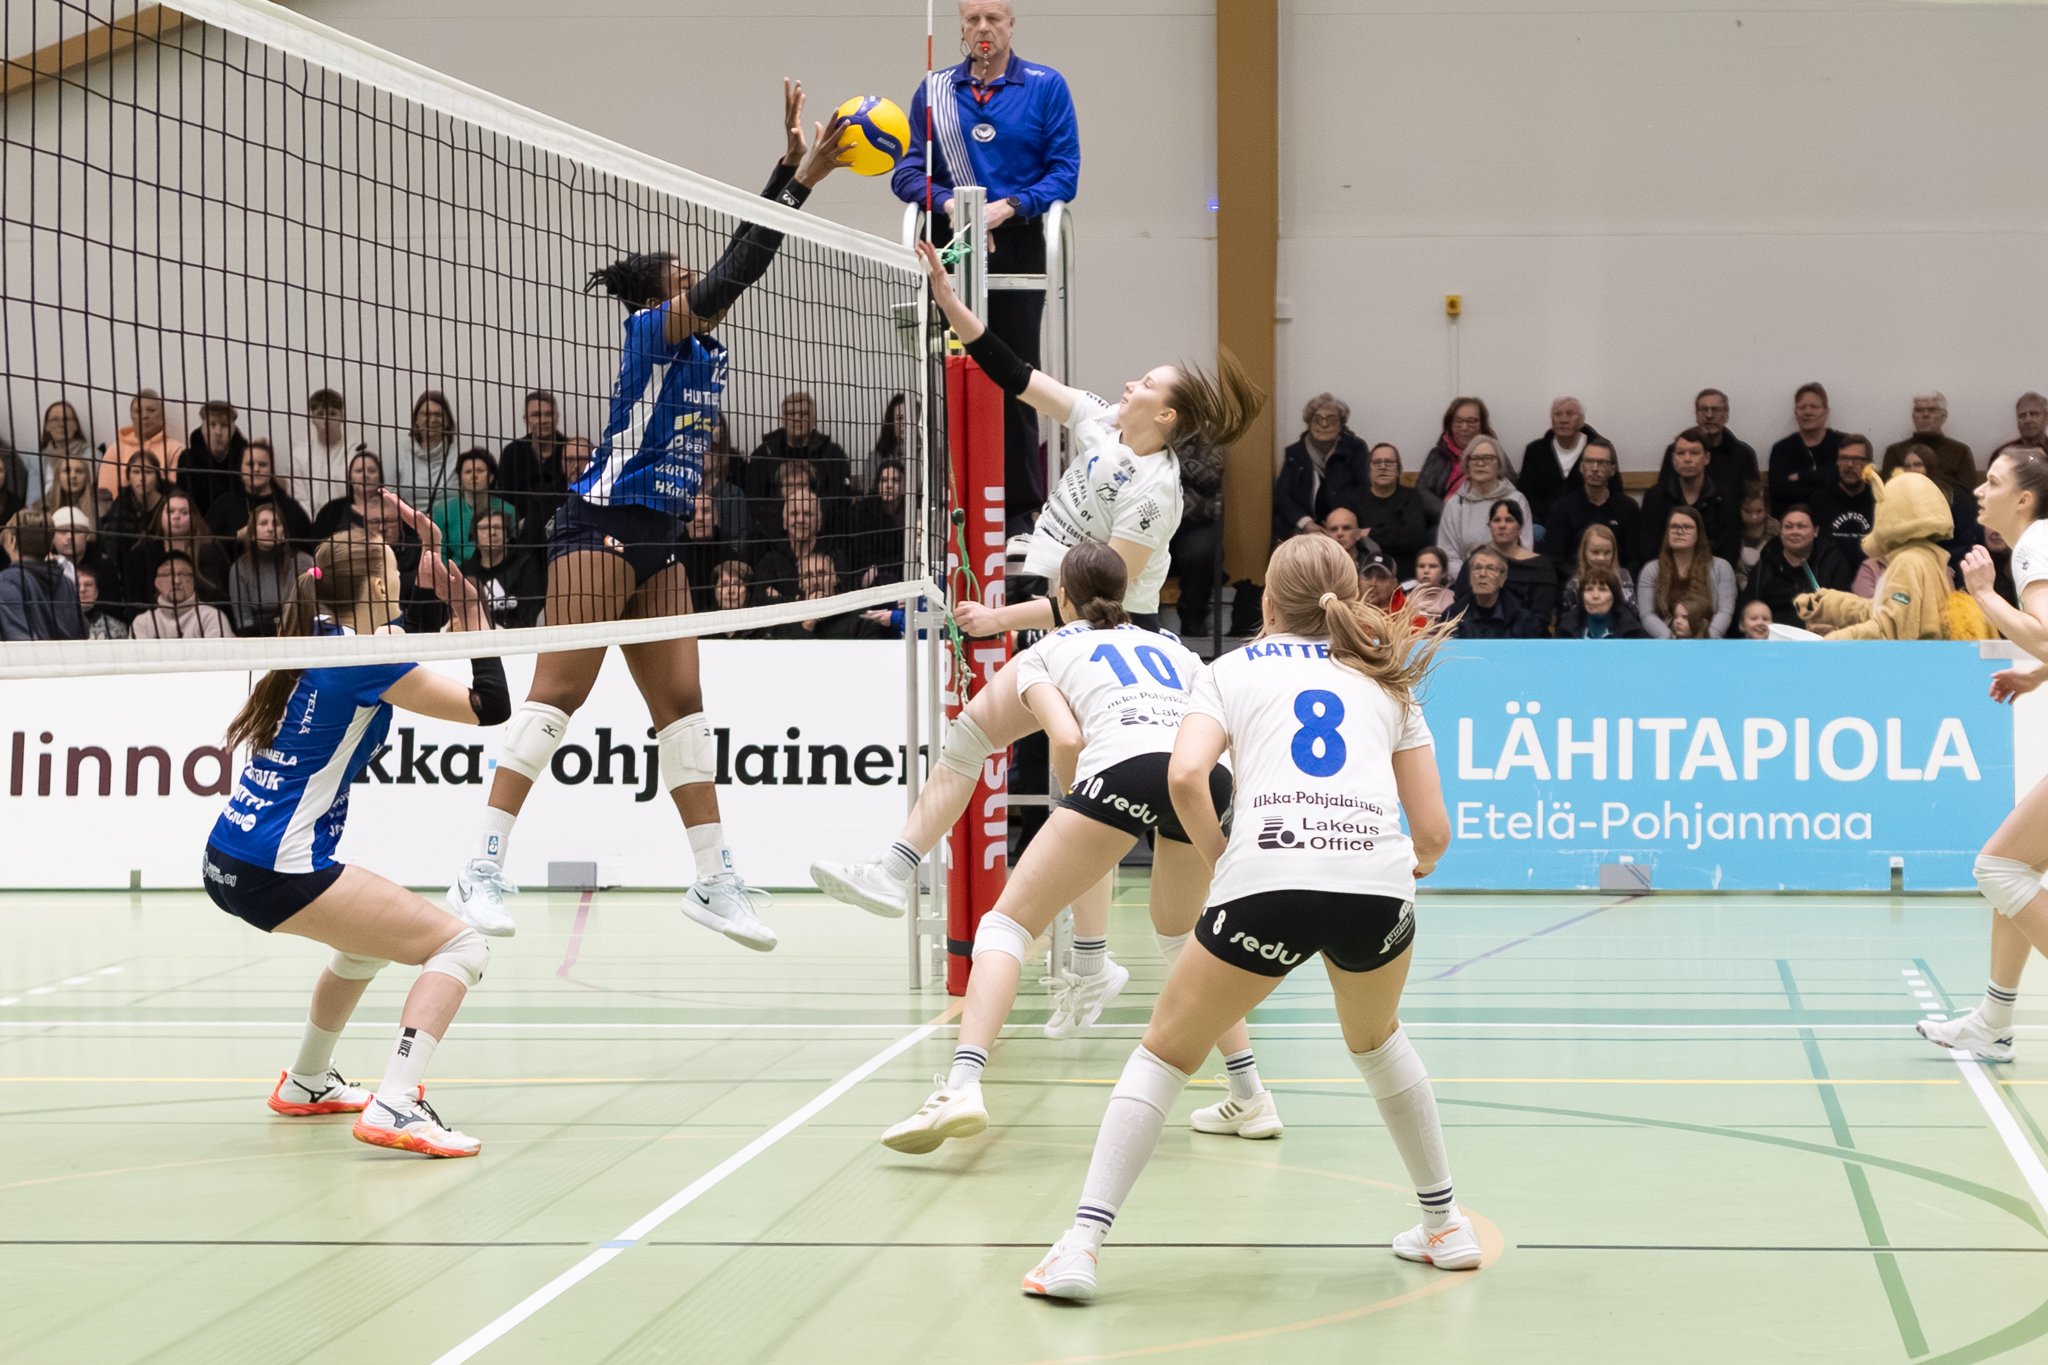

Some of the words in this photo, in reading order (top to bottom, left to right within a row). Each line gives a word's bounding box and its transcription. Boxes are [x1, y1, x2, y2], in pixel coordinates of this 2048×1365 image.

[1090, 643, 1183, 692] 10
[1291, 689, 1347, 778] 8
[1458, 701, 1982, 782] LÄHITAPIOLA
[1081, 776, 1104, 799] 10
[1102, 794, 1157, 824] sedu
[1457, 800, 1873, 850] Etelä-Pohjanmaa
[1302, 817, 1380, 835] Lakeus
[1310, 836, 1375, 851] Office
[1212, 909, 1226, 936] 8
[1229, 931, 1301, 966] sedu
